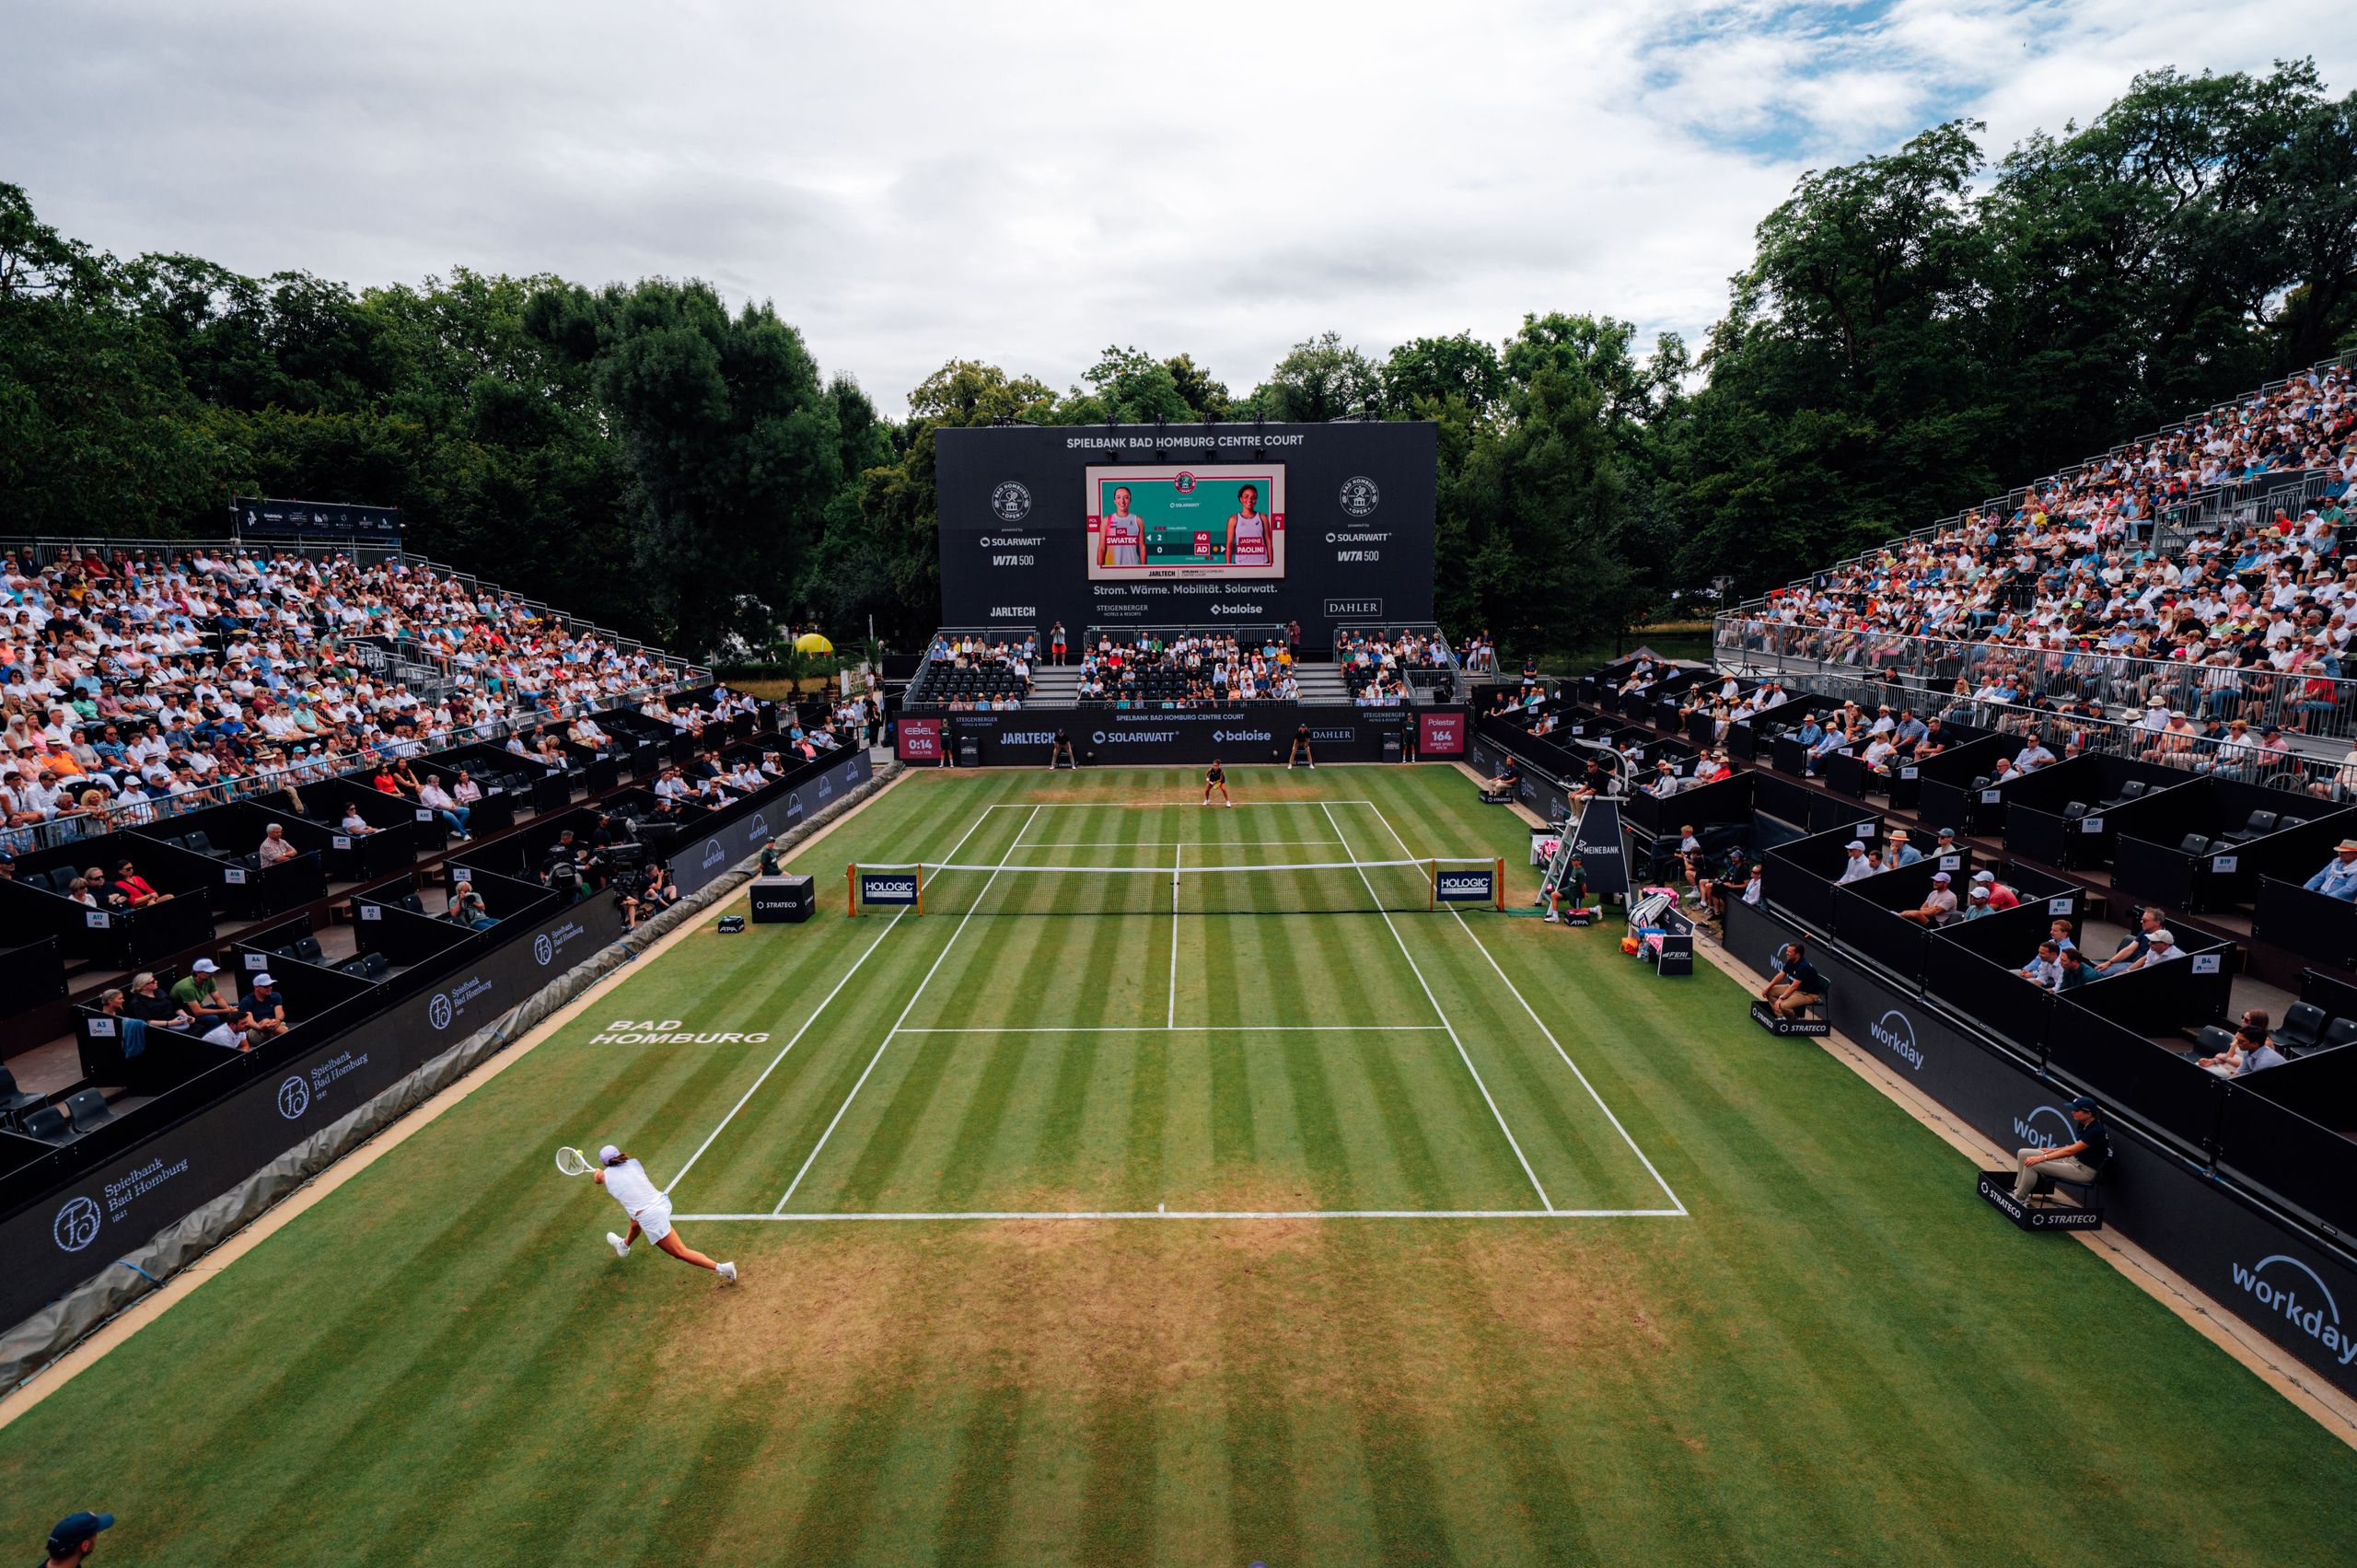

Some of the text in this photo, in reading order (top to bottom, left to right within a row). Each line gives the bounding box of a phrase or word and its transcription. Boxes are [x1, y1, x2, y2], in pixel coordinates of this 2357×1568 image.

[1066, 435, 1304, 448] SPIELBANK BAD HOMBURG CENTRE COURT
[994, 483, 1028, 499] BAD HOMBURG
[1342, 479, 1376, 494] BAD HOMBURG
[993, 555, 1034, 565] WTA 500
[1338, 551, 1379, 562] WTA 500
[1094, 584, 1278, 595] Strom. Wärme. Mobilität. Solarwatt.
[991, 607, 1036, 617] JARLTECH
[1222, 604, 1262, 614] baloise
[1329, 603, 1377, 612] DAHLER
[1000, 732, 1056, 745] JARLTECH
[1226, 729, 1271, 741] baloise
[1312, 730, 1351, 738] DAHLER
[1432, 731, 1452, 741] 164
[909, 739, 933, 749] 0:14
[819, 785, 832, 798] workday
[787, 803, 803, 819] workday
[749, 824, 768, 842] workday
[702, 848, 725, 869] workday
[865, 882, 912, 891] HOLOGIC
[1441, 877, 1488, 888] HOLOGIC
[552, 922, 575, 939] Spielbank
[553, 924, 584, 947] Bad Homburg
[452, 976, 480, 998] Spielbank
[454, 980, 493, 1008] Bad Homburg
[606, 1020, 682, 1031] BAD
[1757, 1011, 1774, 1028] STRATECO
[588, 1032, 771, 1045] HOMBURG
[1870, 1021, 1924, 1071] workday
[311, 1051, 352, 1079] Spielbank
[314, 1053, 368, 1091] Bad Homburg
[2014, 1116, 2064, 1150] work
[104, 1157, 164, 1199] Spielbank
[108, 1158, 190, 1213] Bad Homburg
[1989, 1189, 2021, 1219] STRATECO
[111, 1209, 129, 1224] 1841
[2048, 1214, 2096, 1224] STRATECO
[2233, 1262, 2357, 1365] workday
